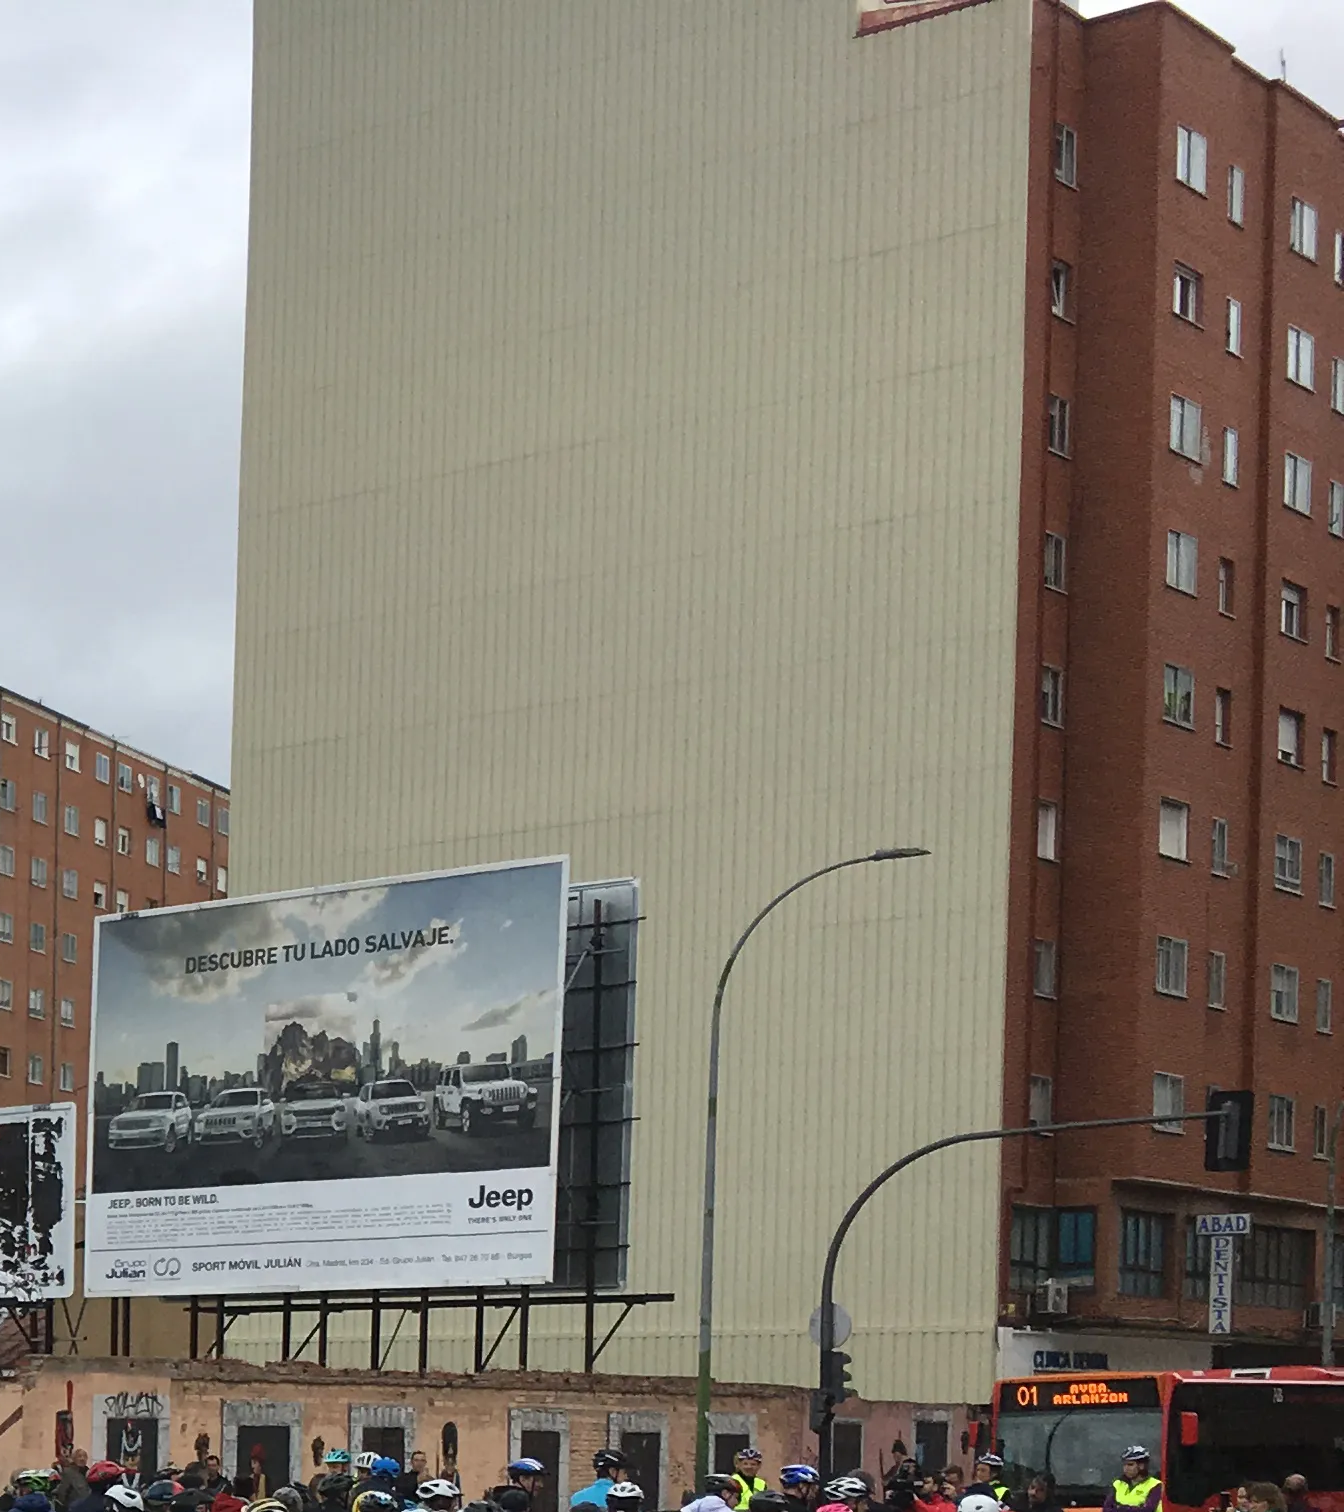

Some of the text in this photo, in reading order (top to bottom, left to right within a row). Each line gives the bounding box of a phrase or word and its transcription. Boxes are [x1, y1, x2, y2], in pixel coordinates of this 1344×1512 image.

[184, 925, 455, 974] DESCUBRE TU LADO SALVAJE.
[135, 1197, 162, 1208] BORN
[164, 1196, 176, 1206] TO
[178, 1195, 190, 1206] BE
[468, 1184, 533, 1211] Jeep
[1198, 1215, 1248, 1233] ABAD
[191, 1261, 226, 1272] SPORT
[228, 1258, 261, 1270] MÓVIL
[263, 1257, 302, 1269] JULIÁN
[1213, 1236, 1229, 1333] DENTISTA
[1017, 1385, 1038, 1407] 01
[1069, 1382, 1112, 1395] AVDA.
[1053, 1392, 1128, 1405] ARLANZON
